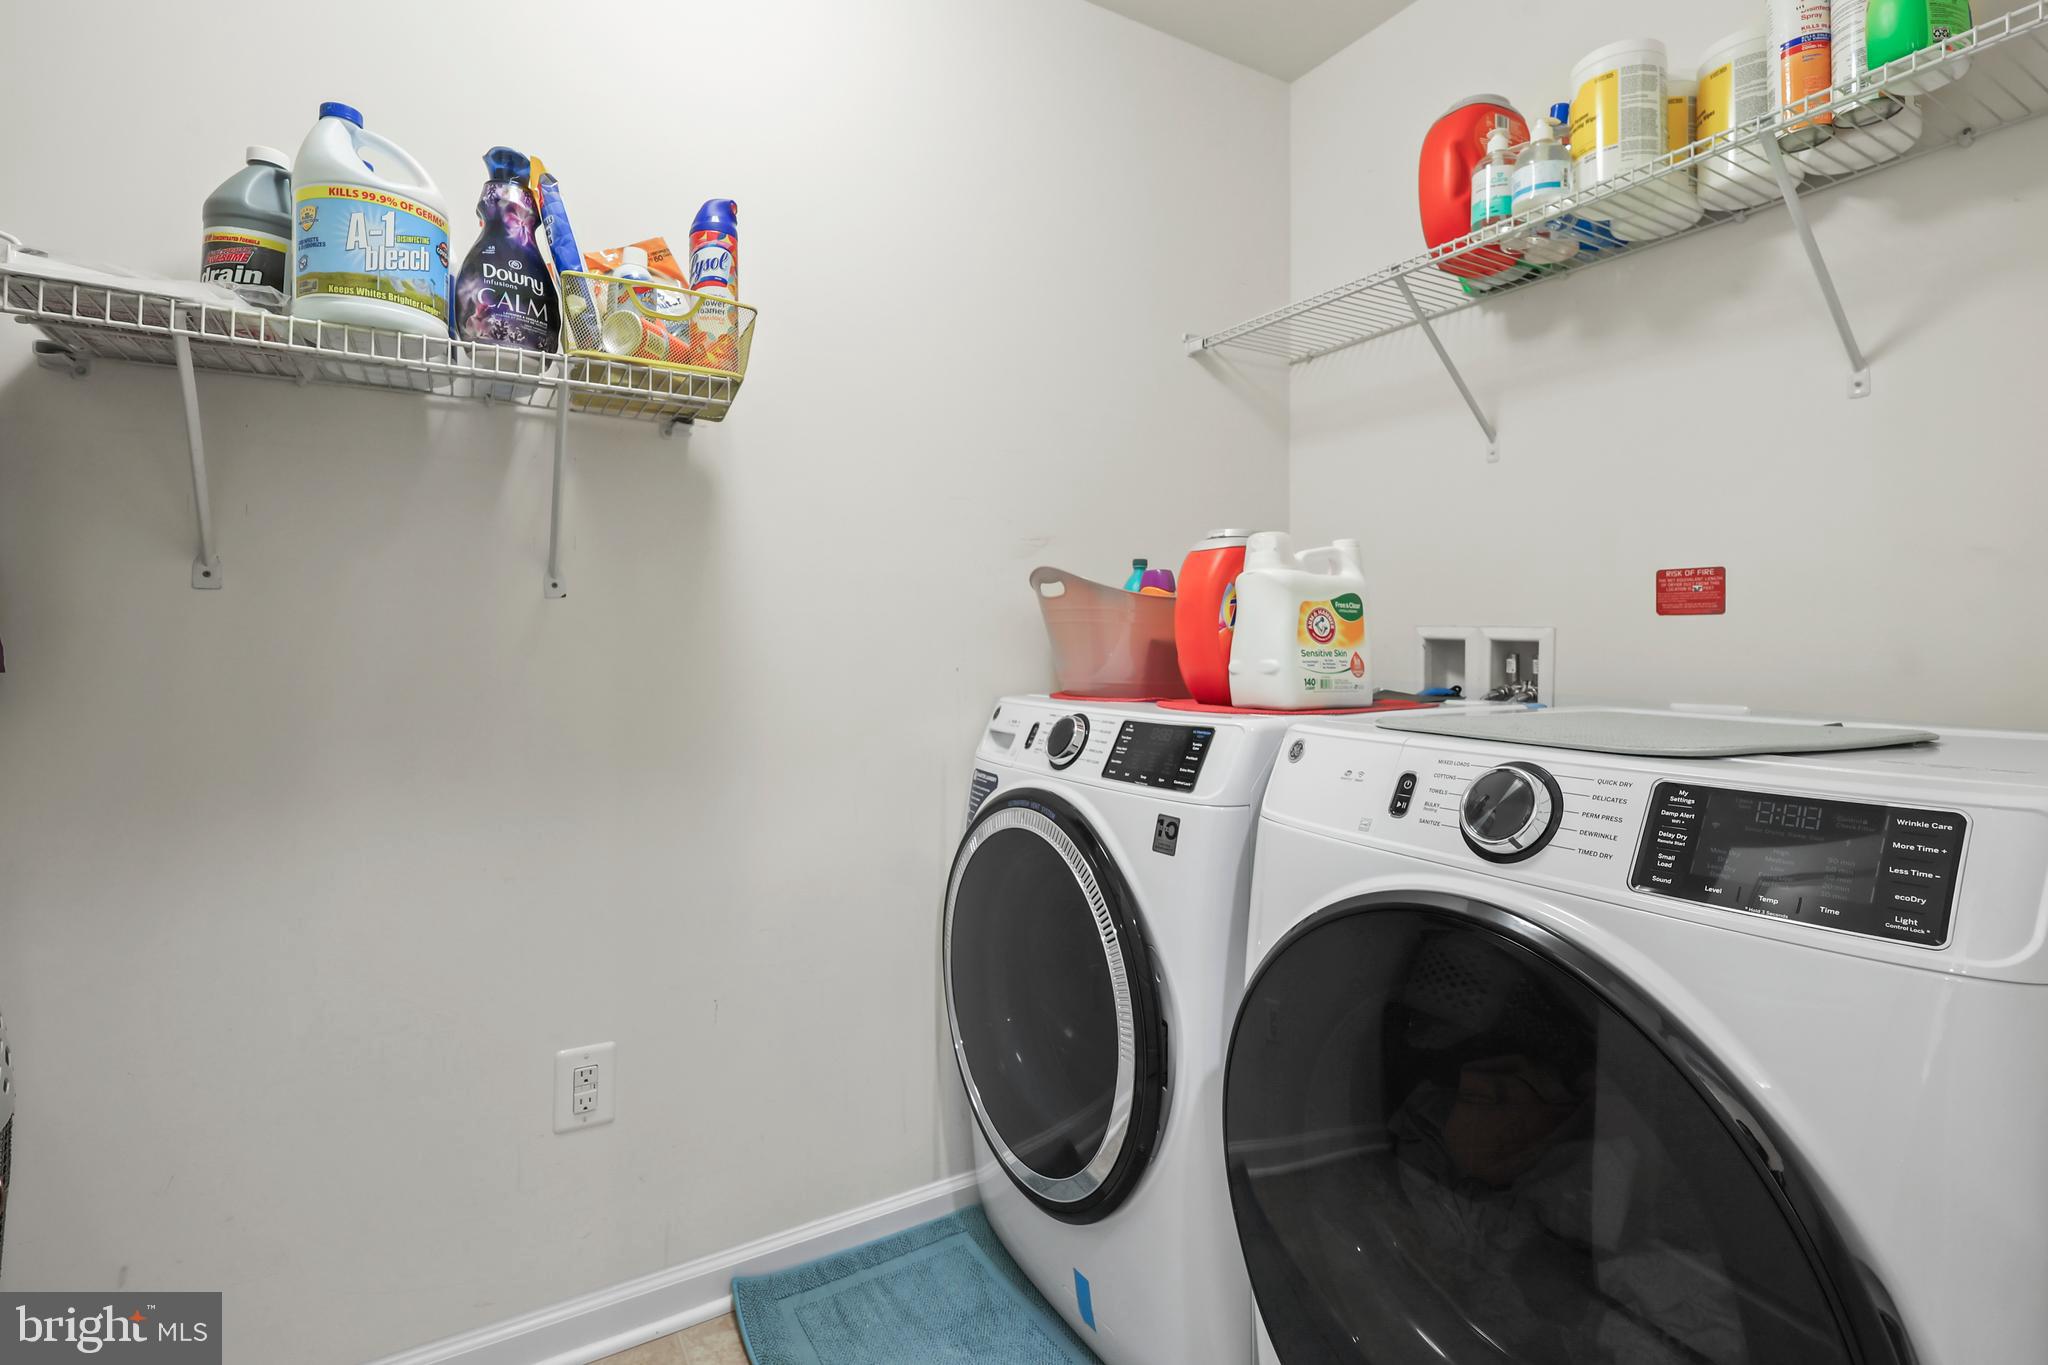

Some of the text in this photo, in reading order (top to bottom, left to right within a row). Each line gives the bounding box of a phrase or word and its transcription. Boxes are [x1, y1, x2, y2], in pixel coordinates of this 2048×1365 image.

[1801, 12, 1822, 20] Spray
[328, 187, 359, 198] KILLS
[361, 191, 398, 207] 99.9%
[399, 201, 414, 211] OF
[345, 210, 396, 252] A-1
[396, 235, 431, 245] DISINFECTING
[365, 245, 431, 272] bleach
[691, 251, 729, 284] Lysol
[201, 265, 262, 284] drain
[482, 263, 544, 296] Downy
[483, 278, 518, 290] Infusions
[328, 284, 354, 295] Keeps
[356, 287, 387, 300] Whites
[388, 292, 420, 309] Brighter
[477, 287, 548, 322] CALM
[1684, 569, 1695, 577] OF
[1697, 568, 1715, 576] FIRE
[1301, 649, 1348, 657] Sensitive Skin
[1304, 678, 1316, 686] 140
[1597, 778, 1633, 788] QUICK DRY
[1679, 789, 1689, 797] My
[1592, 794, 1628, 805] DELICATES
[1669, 795, 1696, 805] Settings
[1581, 811, 1623, 824] PERM PRESS
[1660, 809, 1696, 820] Damp Alert
[1419, 818, 1441, 827] SANITIZE
[1897, 818, 1953, 831] Wrinkle Care
[1579, 829, 1619, 842] DEWRINKLE
[1658, 830, 1688, 841] Delay Dry
[1892, 842, 1915, 851] More
[1917, 844, 1940, 854] Time
[1578, 848, 1614, 861] TIMED DRY
[1658, 852, 1676, 861] Small
[1889, 866, 1909, 876] Less
[1911, 869, 1934, 879] Time
[1652, 875, 1672, 884] Sound
[1704, 885, 1723, 894] Level
[1759, 895, 1779, 905] Temp
[1894, 894, 1927, 905] ecoDry
[1819, 906, 1841, 916] Time
[1895, 915, 1918, 926] Light
[1885, 922, 1926, 934] Control Lock
